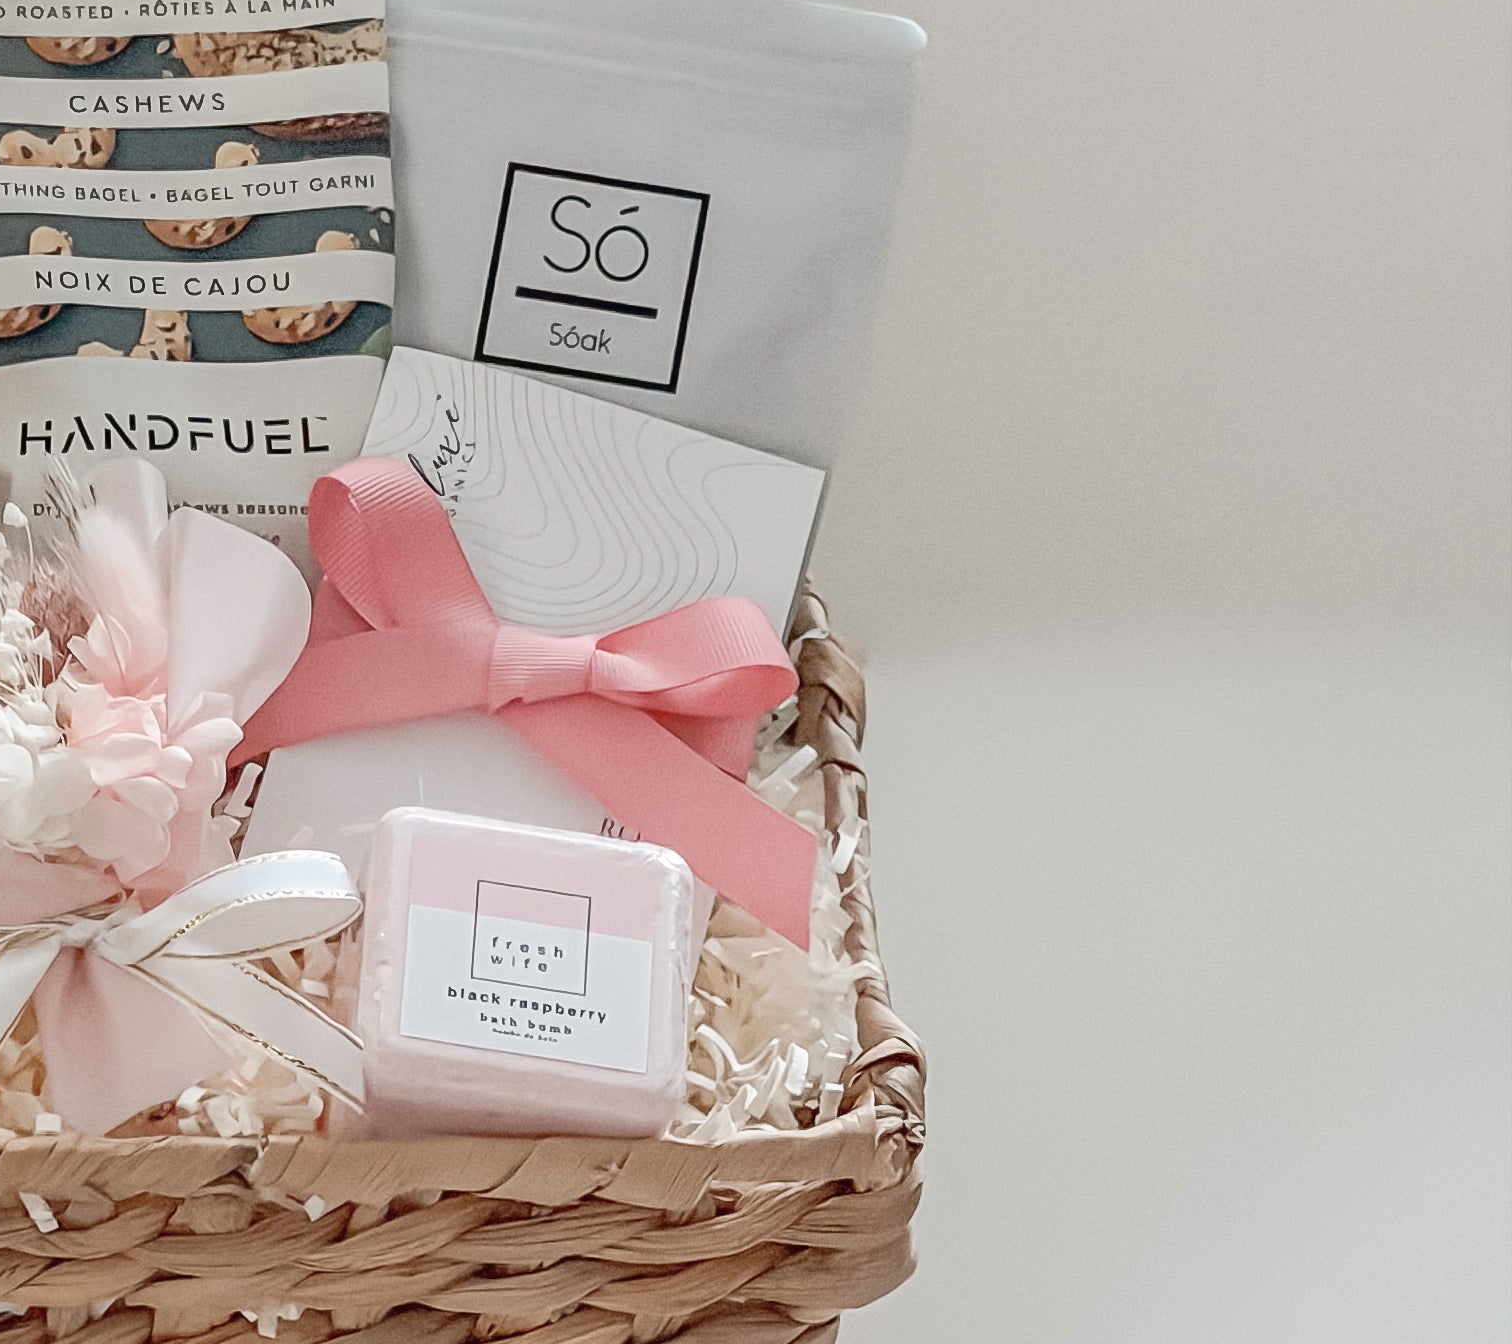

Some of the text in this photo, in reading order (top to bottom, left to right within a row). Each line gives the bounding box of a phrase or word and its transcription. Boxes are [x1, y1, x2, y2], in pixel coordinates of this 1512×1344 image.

[16, 4, 113, 20] ROASTED
[139, 0, 214, 18] RÔTIES
[248, 0, 272, 15] LA
[69, 92, 227, 114] CASHEWS
[75, 186, 141, 204] BAGEL
[167, 185, 234, 203] BAGEL
[243, 179, 299, 198] TOUT
[310, 174, 375, 194] GARNI
[543, 194, 650, 283] Só
[35, 270, 291, 297] NOIX DE CAJOU
[549, 322, 612, 354] Sóak
[19, 412, 330, 455] HANDFUEL
[237, 503, 309, 516] seasone
[492, 936, 564, 959] fresh
[490, 954, 548, 973] wife
[447, 986, 607, 1024] black raspberry
[480, 1012, 573, 1035] bath bomb
